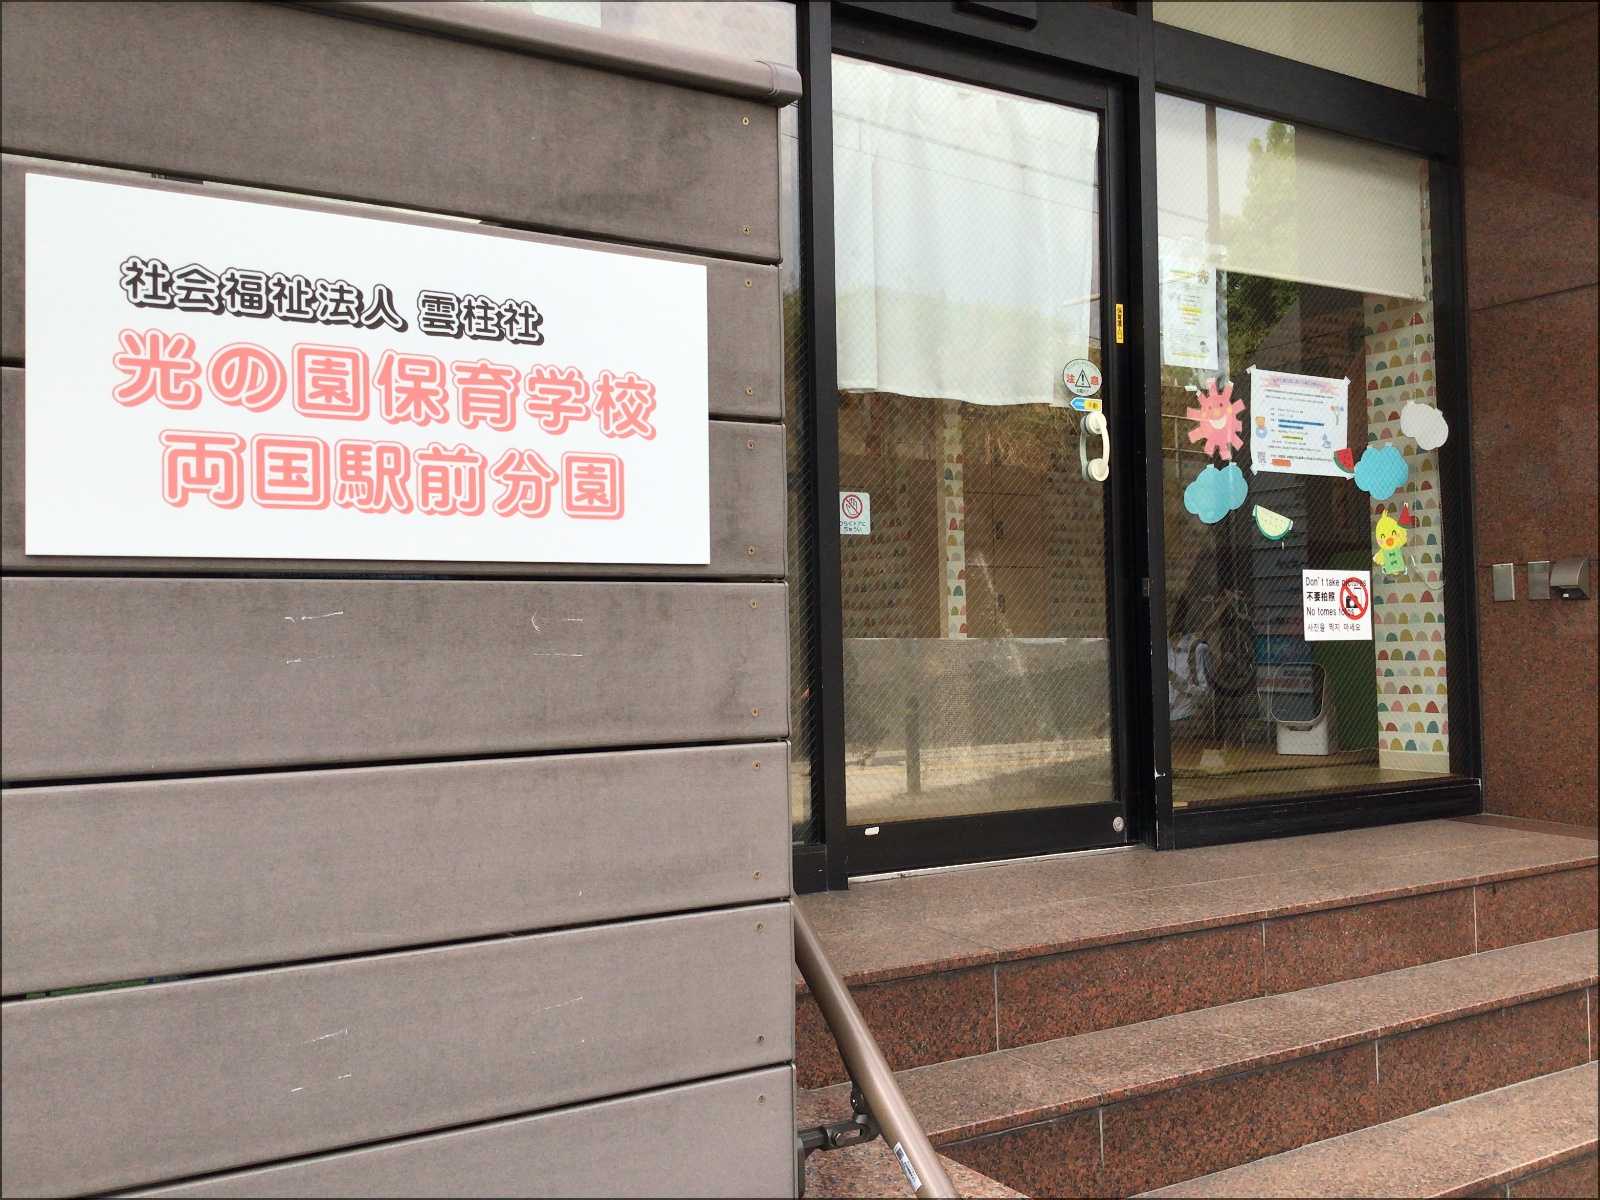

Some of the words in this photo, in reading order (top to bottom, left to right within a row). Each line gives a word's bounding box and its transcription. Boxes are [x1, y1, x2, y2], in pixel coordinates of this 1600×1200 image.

[119, 254, 408, 332] 社会福祉法人
[416, 288, 545, 346] 雲柱社
[112, 327, 657, 441] 光の園保育学校
[158, 428, 625, 521] 両国駅前分園
[1306, 606, 1316, 616] No
[1317, 607, 1337, 616] tomes
[1326, 577, 1339, 587] take
